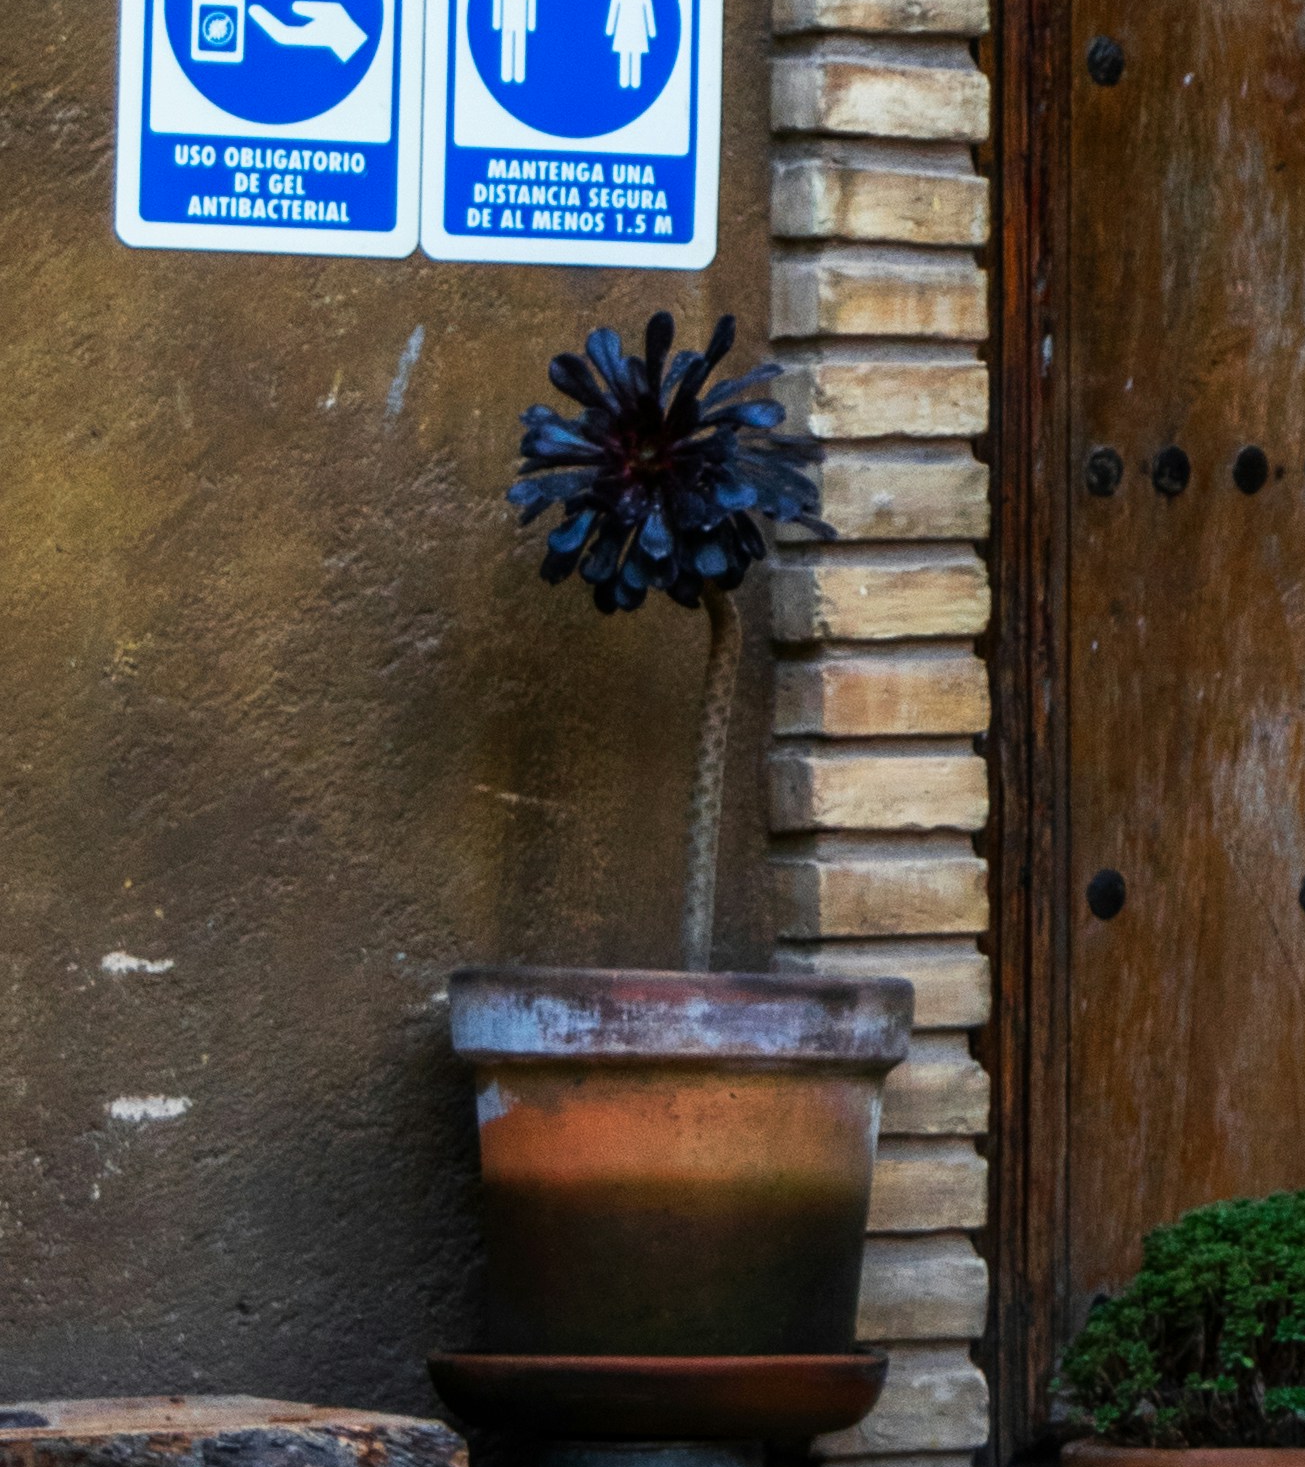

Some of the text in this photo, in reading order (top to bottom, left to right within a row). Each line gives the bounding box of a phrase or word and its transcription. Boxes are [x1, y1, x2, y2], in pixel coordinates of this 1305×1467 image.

[174, 144, 367, 174] USO OBLIGATORIO
[487, 158, 656, 186] MANTENGA UNA
[234, 172, 306, 196] DE GEL
[473, 182, 668, 210] DISTANCIA SEGURA
[187, 195, 351, 223] ANTIBACTERIAL
[466, 208, 674, 235] DE AL MENOS 1.5 M
